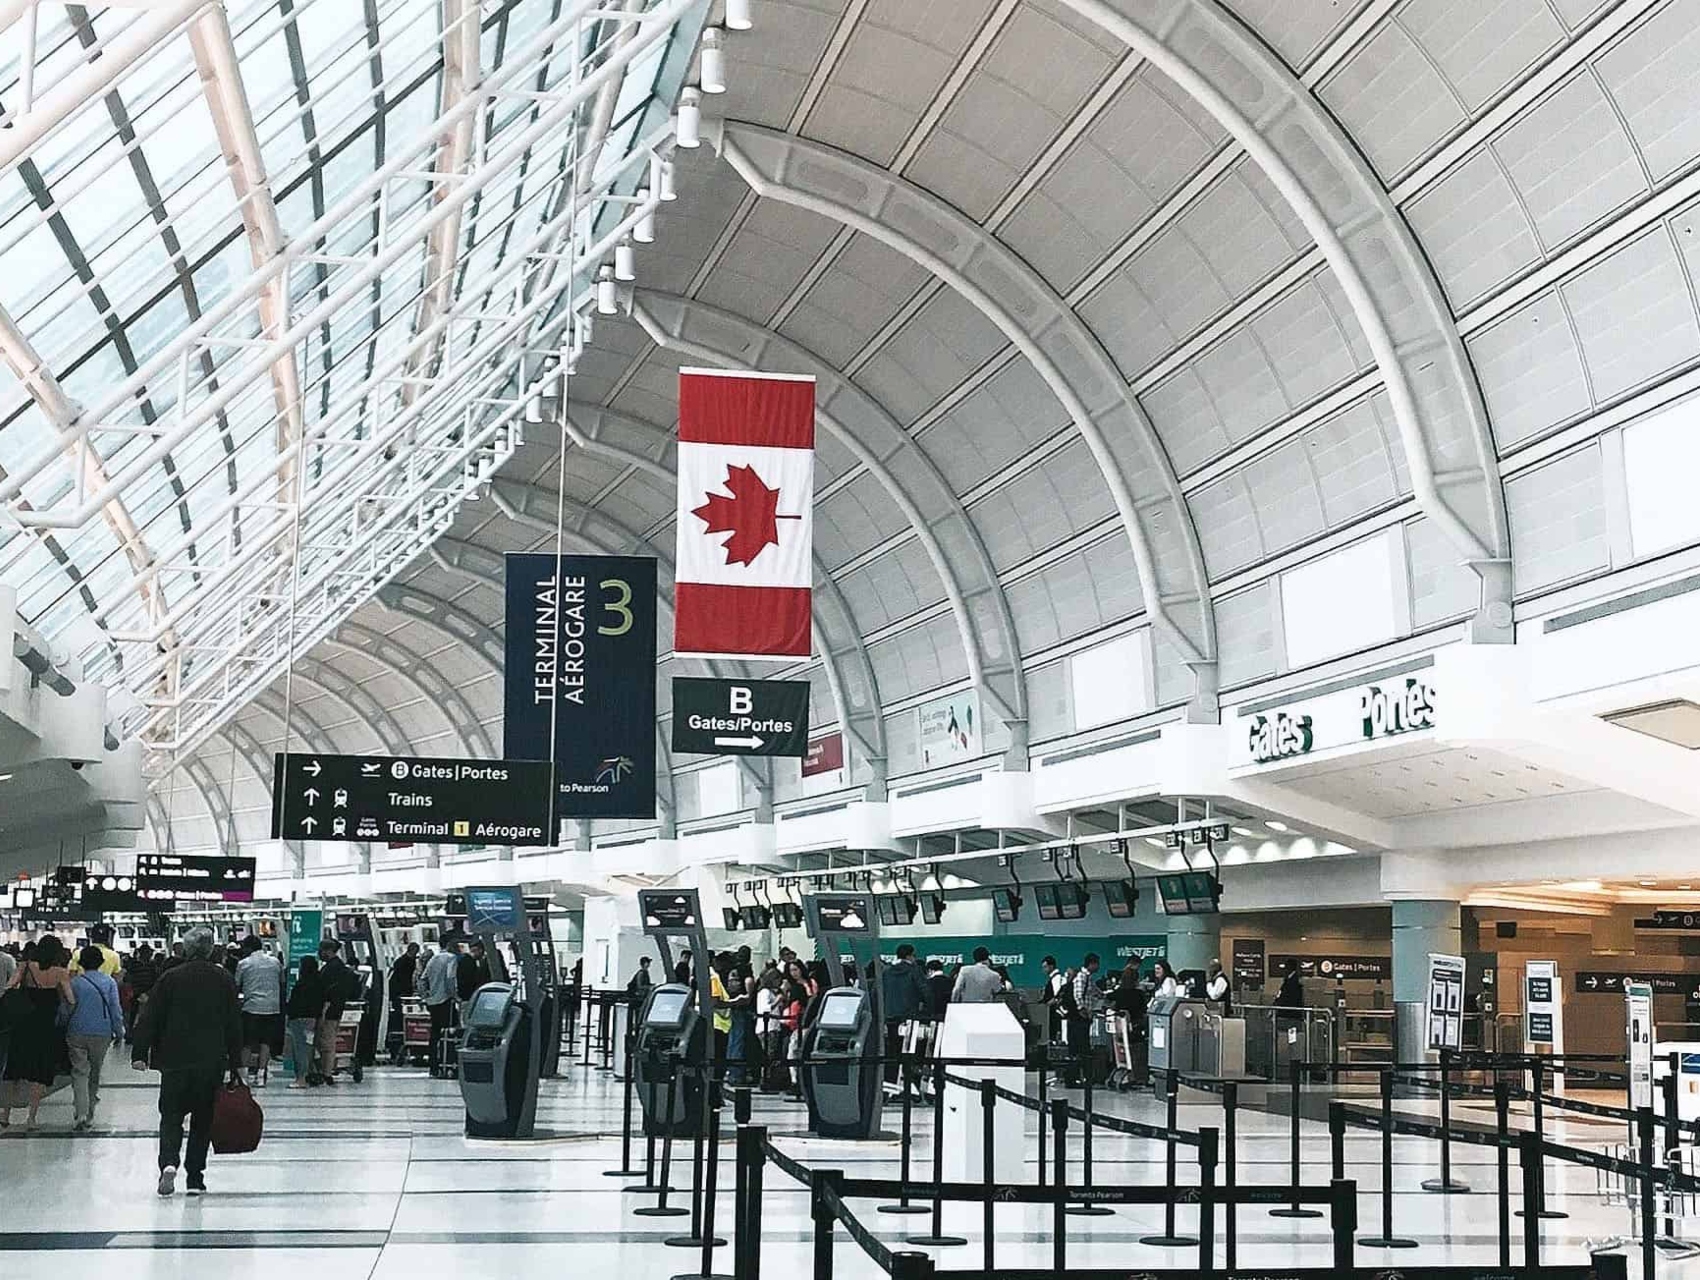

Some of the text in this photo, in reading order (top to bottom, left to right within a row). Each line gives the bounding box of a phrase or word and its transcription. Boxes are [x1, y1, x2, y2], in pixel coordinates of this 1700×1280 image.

[597, 579, 634, 635] 3
[534, 575, 556, 705] TERMINAL
[559, 576, 585, 705] AÉROGARE
[729, 686, 753, 714] B
[688, 714, 793, 733] Gates/Portes
[1248, 678, 1438, 764] Gates Portes
[412, 764, 453, 778] Gates
[461, 766, 508, 780] Portes
[571, 783, 609, 792] Pearson
[387, 792, 433, 807] Trains
[386, 820, 449, 835] Terminal
[475, 822, 542, 838] Aérogare
